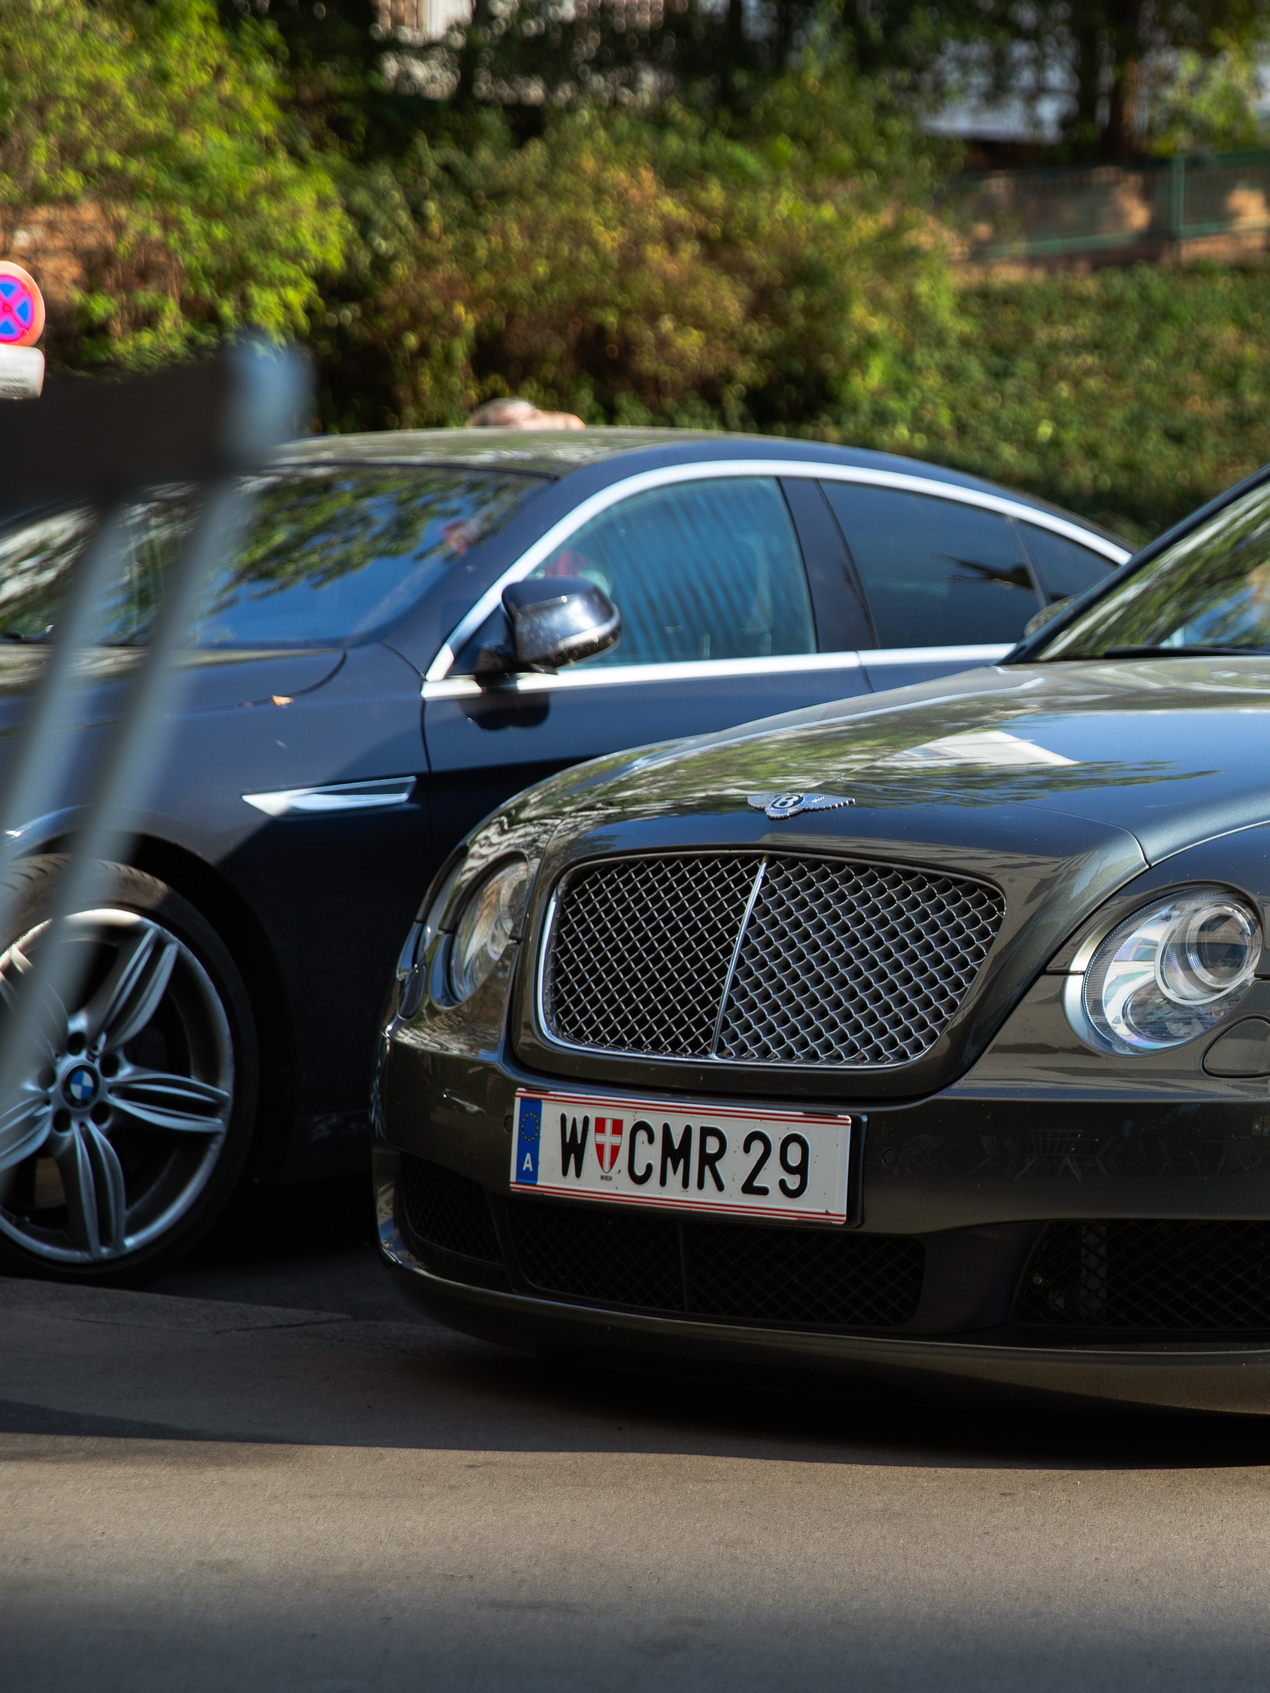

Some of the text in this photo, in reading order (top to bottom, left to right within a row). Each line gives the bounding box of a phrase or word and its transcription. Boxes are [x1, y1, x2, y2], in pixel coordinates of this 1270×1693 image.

[522, 1152, 533, 1172] A
[560, 1112, 811, 1200] W CMR 29
